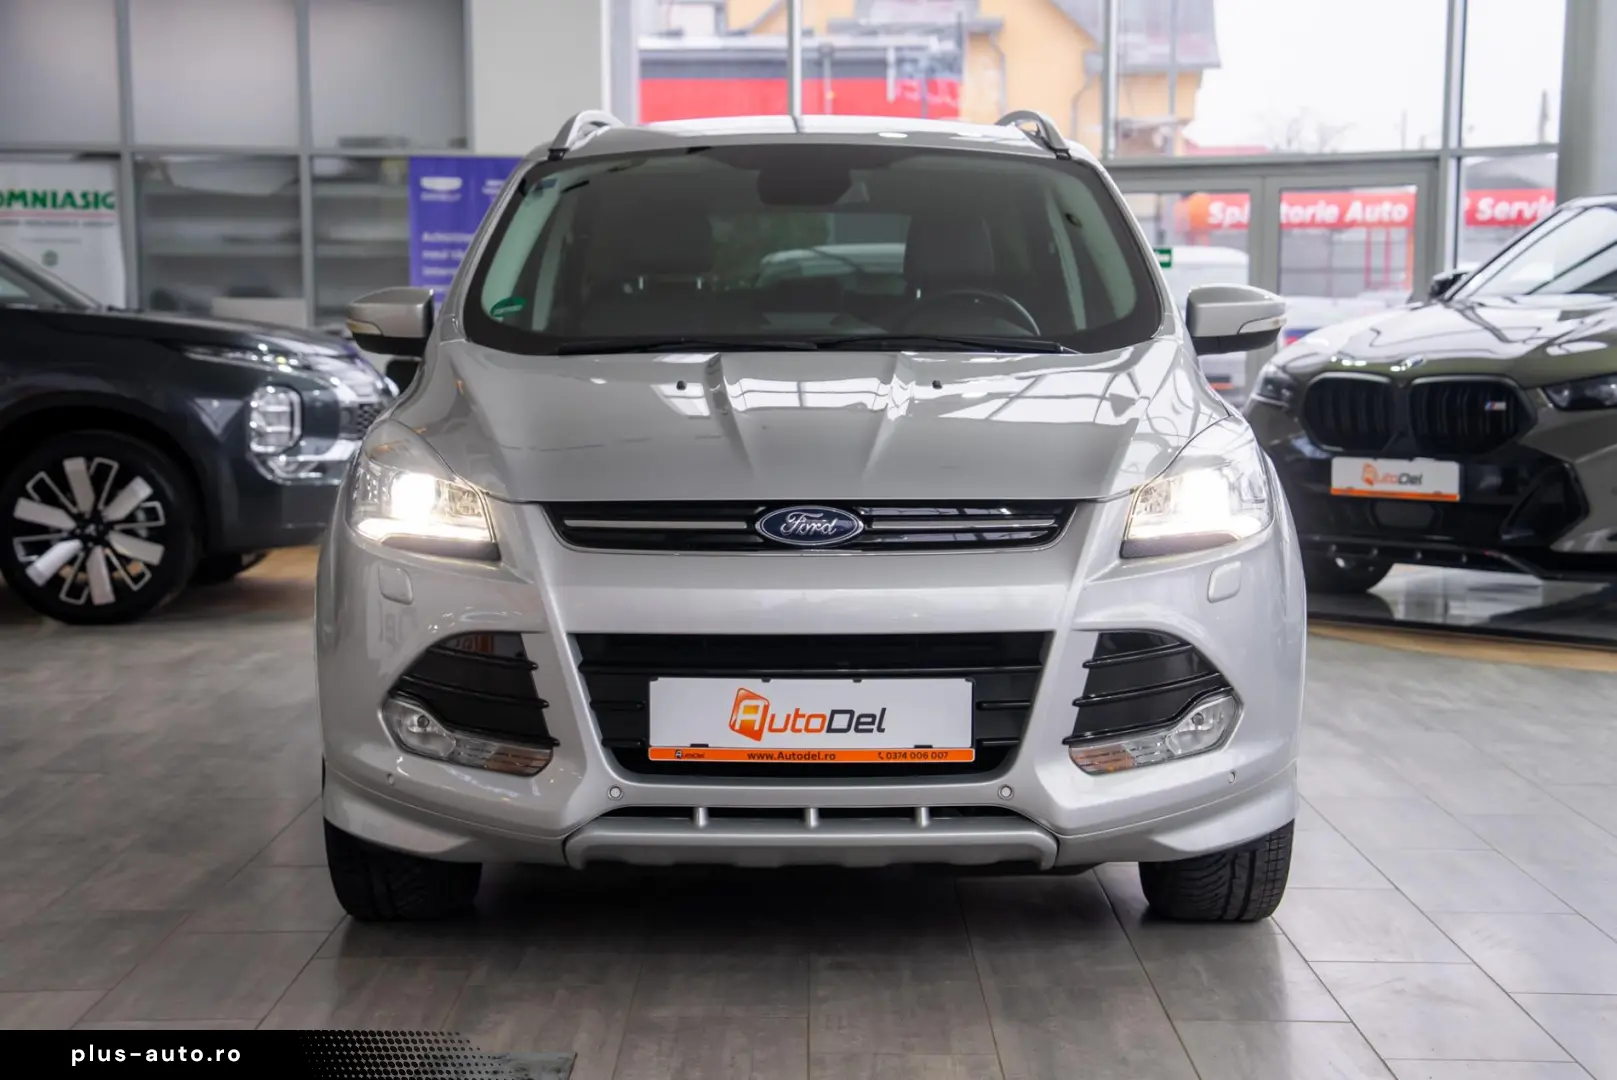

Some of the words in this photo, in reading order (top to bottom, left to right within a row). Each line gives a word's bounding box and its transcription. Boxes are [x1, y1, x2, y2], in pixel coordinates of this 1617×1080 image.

[0, 188, 116, 210] MNIASIG
[1344, 199, 1409, 223] Auto
[780, 511, 838, 536] Ford
[729, 687, 887, 742] AutoDel
[747, 751, 836, 761] www.Autodel.ro
[886, 751, 907, 760] 0374
[909, 751, 928, 760] 006
[930, 751, 949, 760] 007
